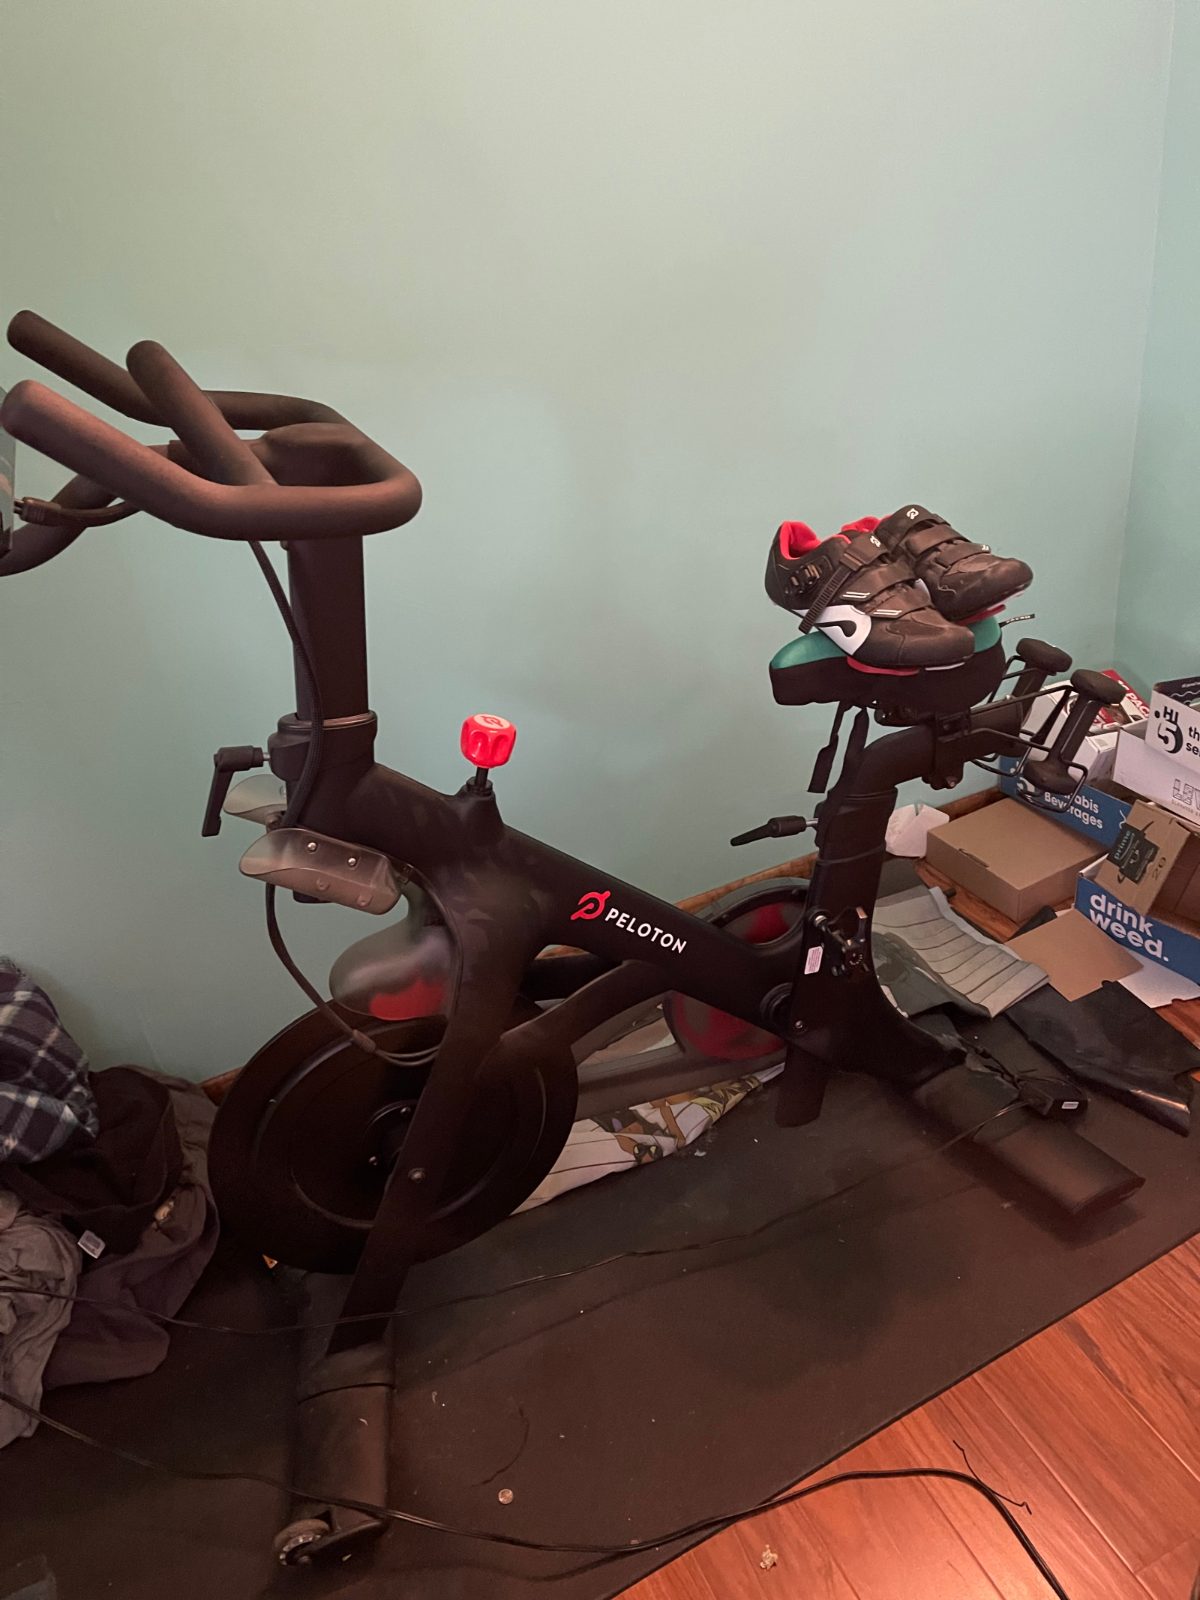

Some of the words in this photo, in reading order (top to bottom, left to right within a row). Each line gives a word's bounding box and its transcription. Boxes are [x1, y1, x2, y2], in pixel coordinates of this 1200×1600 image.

[1125, 692, 1150, 719] PAC
[1186, 742, 1200, 757] se
[604, 907, 687, 954] PELOTON
[1089, 908, 1169, 962] weed.
[1090, 893, 1153, 937] drink
